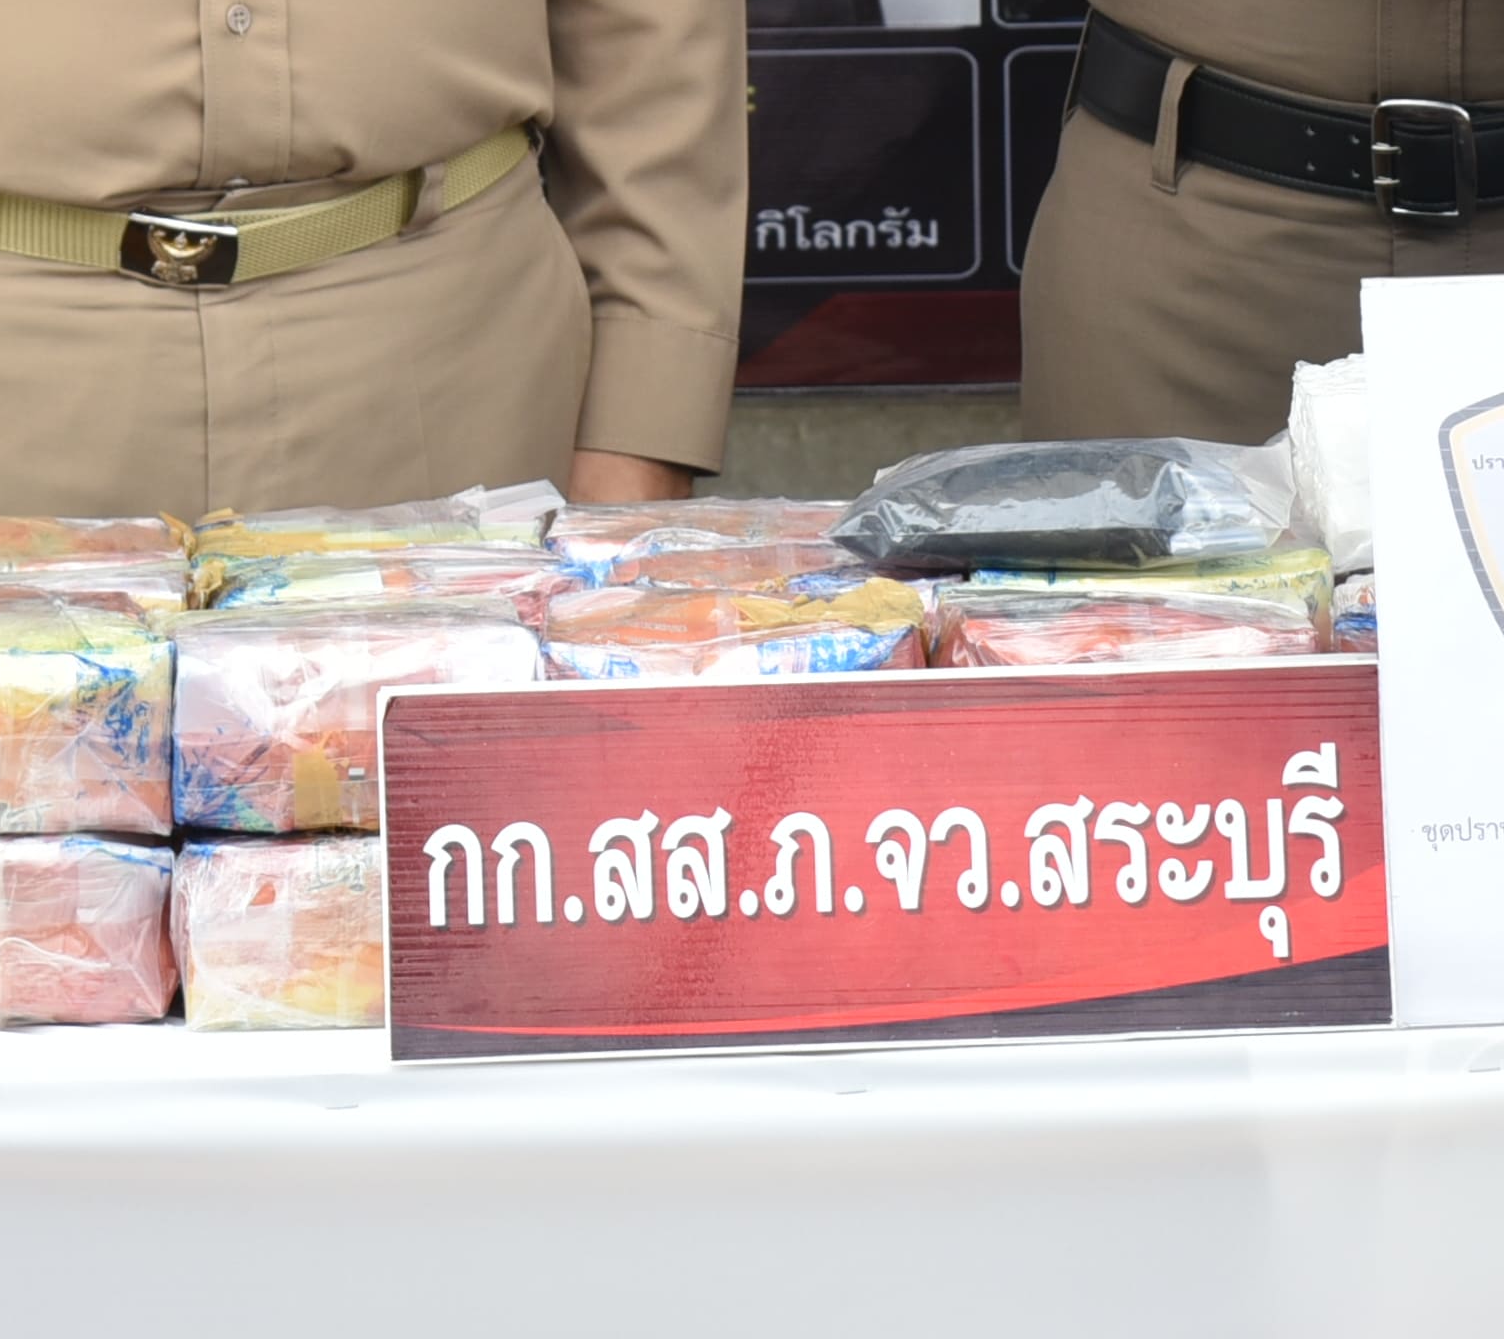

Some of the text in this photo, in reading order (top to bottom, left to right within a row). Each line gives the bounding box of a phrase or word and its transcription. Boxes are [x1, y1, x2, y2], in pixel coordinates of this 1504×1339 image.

[755, 204, 939, 251] กิโลกรัม
[422, 741, 1346, 960] กก.สส.ภ.จว.สระบุรี
